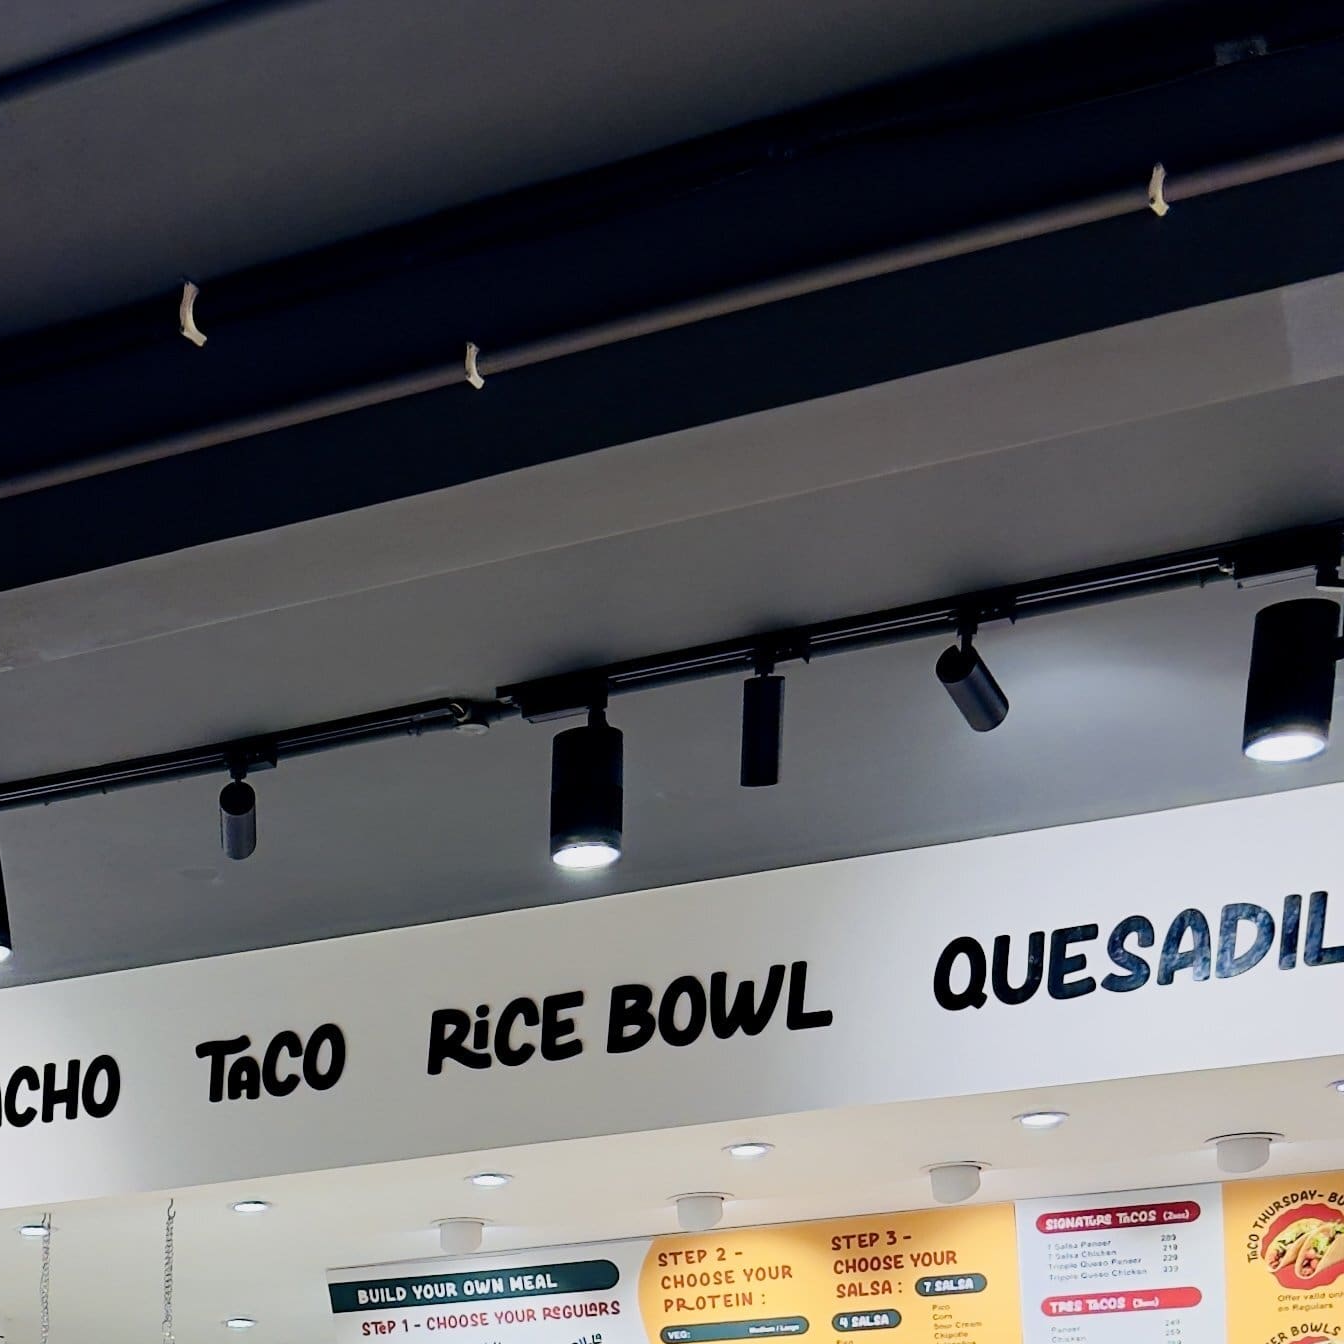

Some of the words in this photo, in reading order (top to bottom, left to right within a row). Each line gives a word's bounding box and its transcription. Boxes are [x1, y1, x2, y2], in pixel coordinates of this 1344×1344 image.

[607, 960, 834, 1055] BOWL
[831, 1232, 880, 1251] STEP
[886, 1230, 897, 1246] 3
[658, 1250, 707, 1267] STEP
[716, 1247, 726, 1261] 2
[833, 1254, 905, 1275] CHOOSE
[909, 1250, 958, 1268] YOUR
[661, 1270, 736, 1290] CHOOSE
[743, 1265, 793, 1282] YOUR
[923, 1282, 931, 1293] 7
[934, 1278, 974, 1292] SALSA
[358, 1287, 406, 1305] BUILD
[412, 1283, 457, 1300] YOUR
[464, 1279, 503, 1295] OWN
[510, 1273, 557, 1292] MEAL
[836, 1279, 893, 1299] SALSA
[664, 1292, 753, 1312] PROTEIN
[403, 1319, 408, 1332] 1
[427, 1313, 488, 1330] CHOOSE
[494, 1310, 536, 1324] YOUR
[851, 1314, 889, 1327] SALSA
[1290, 1322, 1342, 1337] BOWLS
